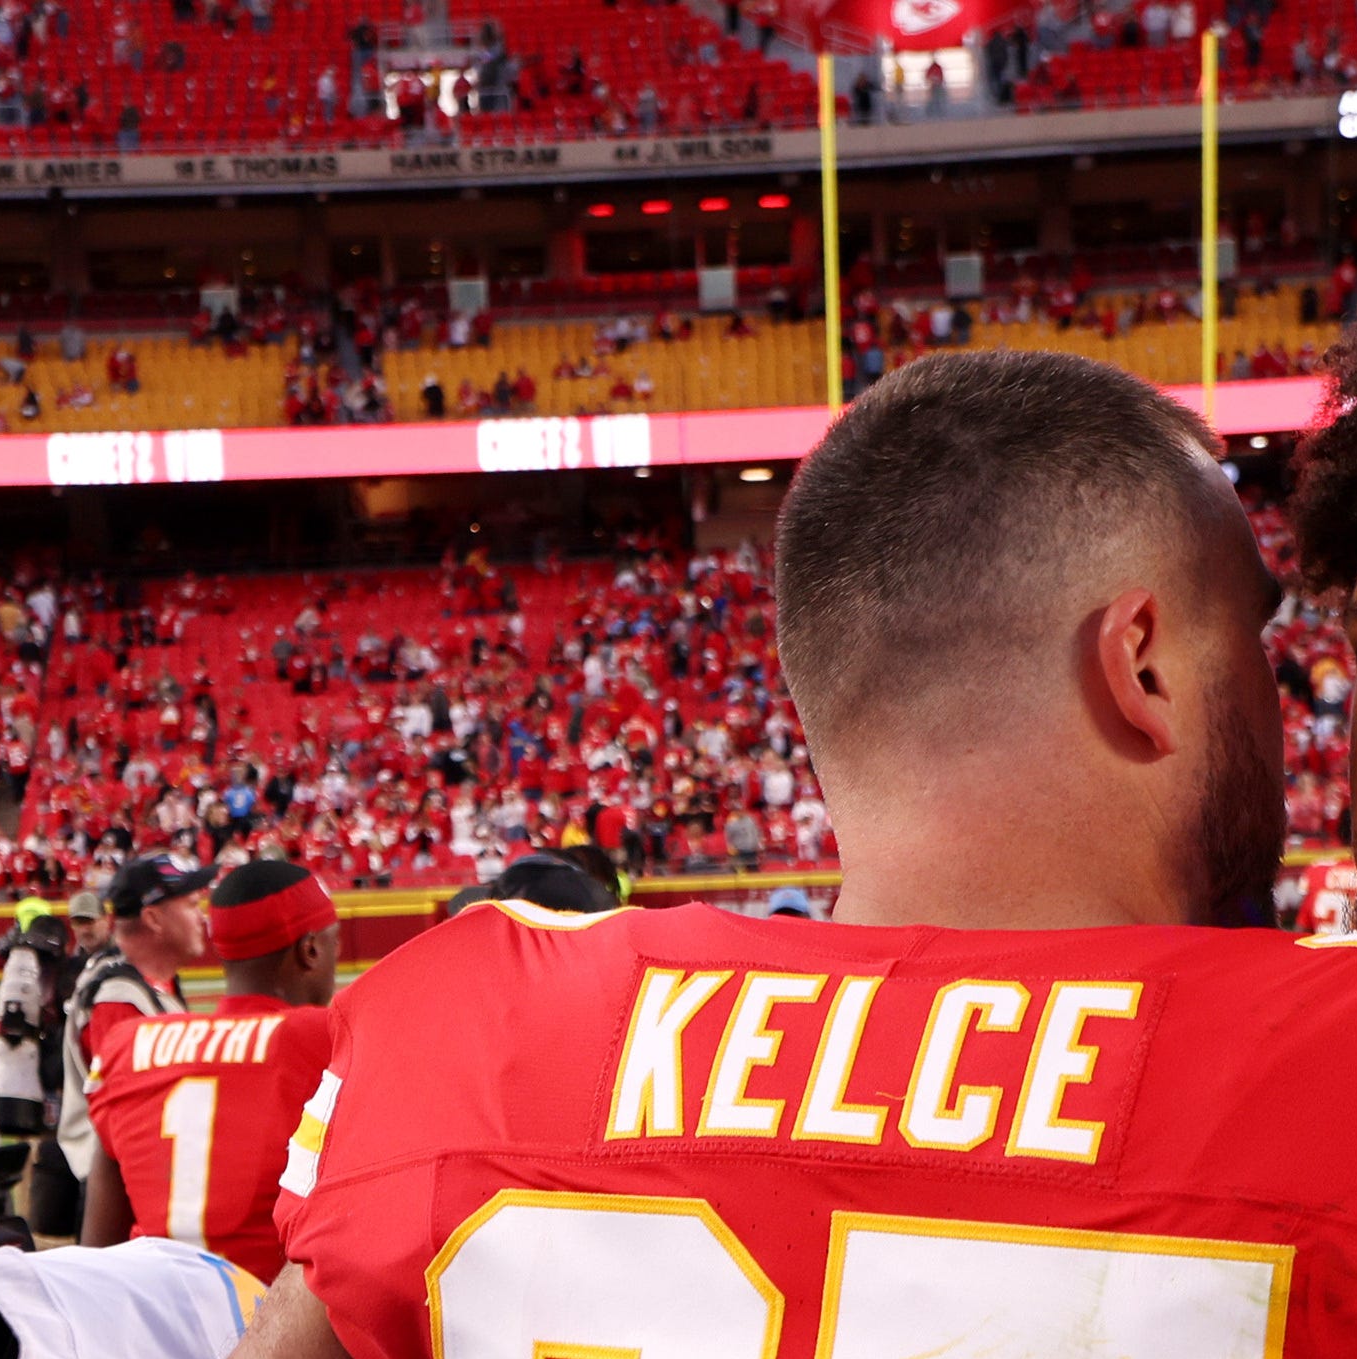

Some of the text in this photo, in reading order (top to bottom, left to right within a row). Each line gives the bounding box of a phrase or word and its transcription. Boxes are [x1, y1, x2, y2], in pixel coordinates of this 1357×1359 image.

[231, 154, 339, 182] THOMAS
[470, 145, 560, 172] STRAM
[674, 137, 773, 163] WILSON
[132, 1014, 285, 1073] WORTHY
[603, 966, 1144, 1165] KELCE
[160, 1077, 218, 1247] 1
